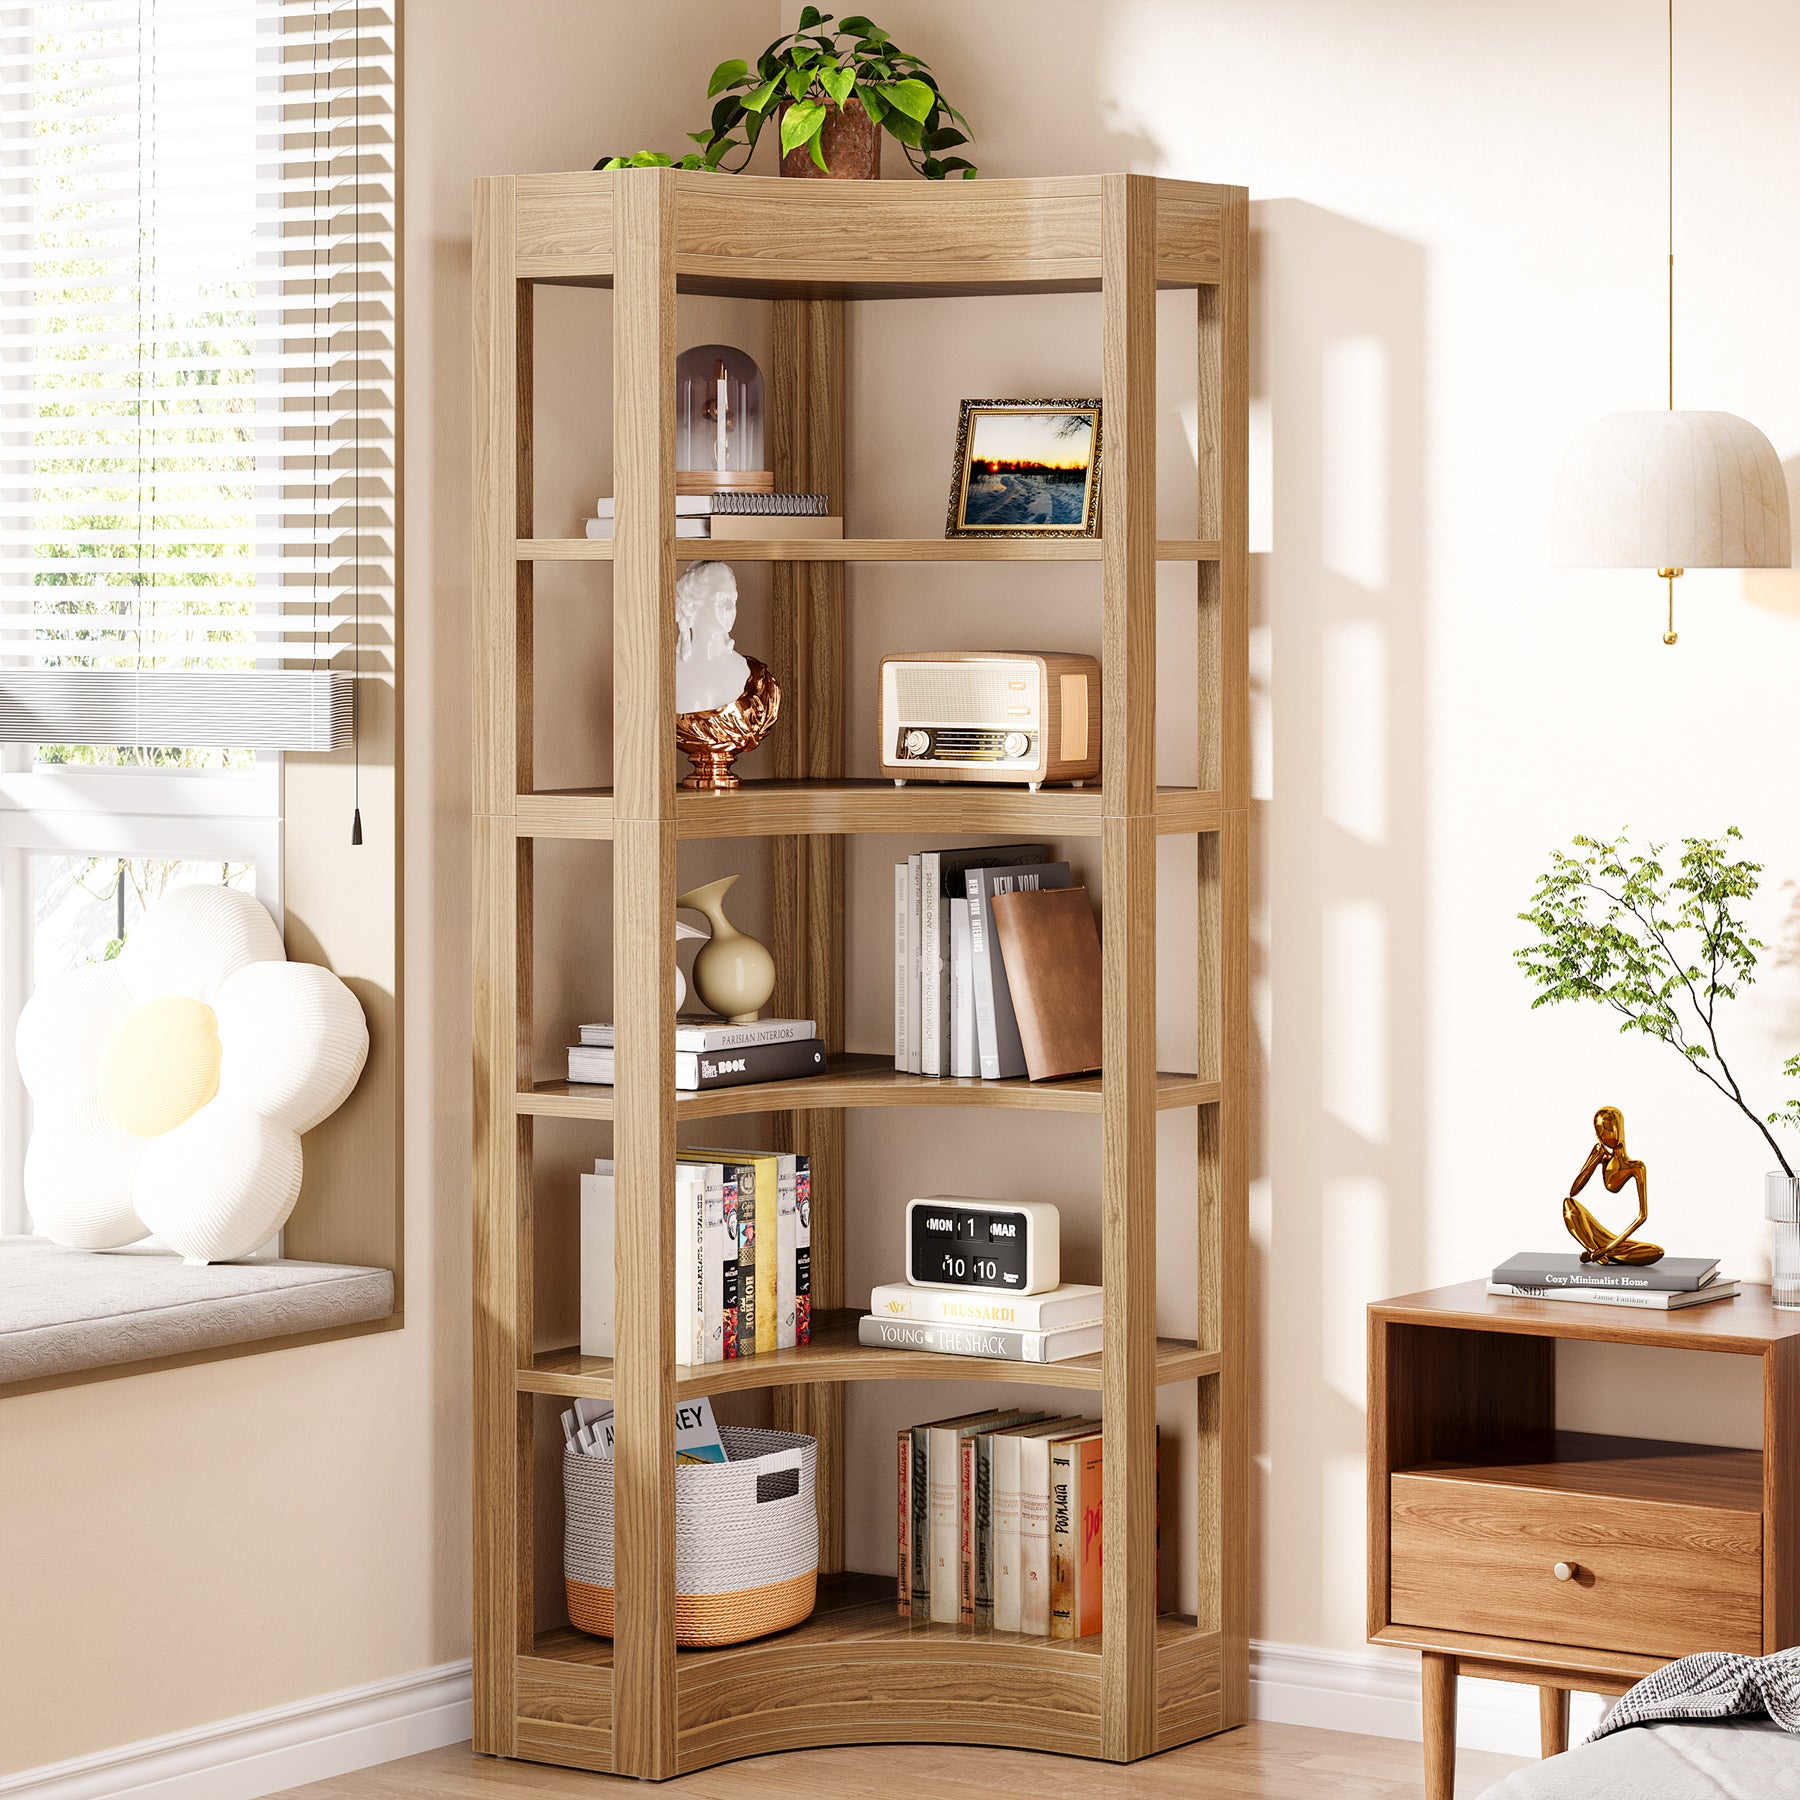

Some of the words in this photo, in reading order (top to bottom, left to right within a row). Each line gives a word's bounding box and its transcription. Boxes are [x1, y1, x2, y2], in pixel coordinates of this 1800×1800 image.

[968, 879, 979, 895] NEW
[970, 898, 981, 916] YORK
[971, 919, 983, 953] INTERIORS
[721, 1032, 756, 1046] PARISIAN
[757, 1028, 794, 1042] INTERIORS
[717, 1058, 747, 1074] BOOK
[929, 1217, 953, 1232] MON
[967, 1217, 975, 1237] 1
[991, 1222, 1017, 1238] MAR
[946, 1257, 966, 1277] 10
[977, 1260, 998, 1280] 10
[1545, 1274, 1568, 1285] Cozy
[1570, 1275, 1619, 1286] Minimalist
[1621, 1277, 1649, 1287] Home
[940, 1301, 1016, 1322] TRUSSARDI
[879, 1324, 924, 1345] YOUNG
[937, 1330, 962, 1351] THE
[965, 1332, 1007, 1355] SHACK
